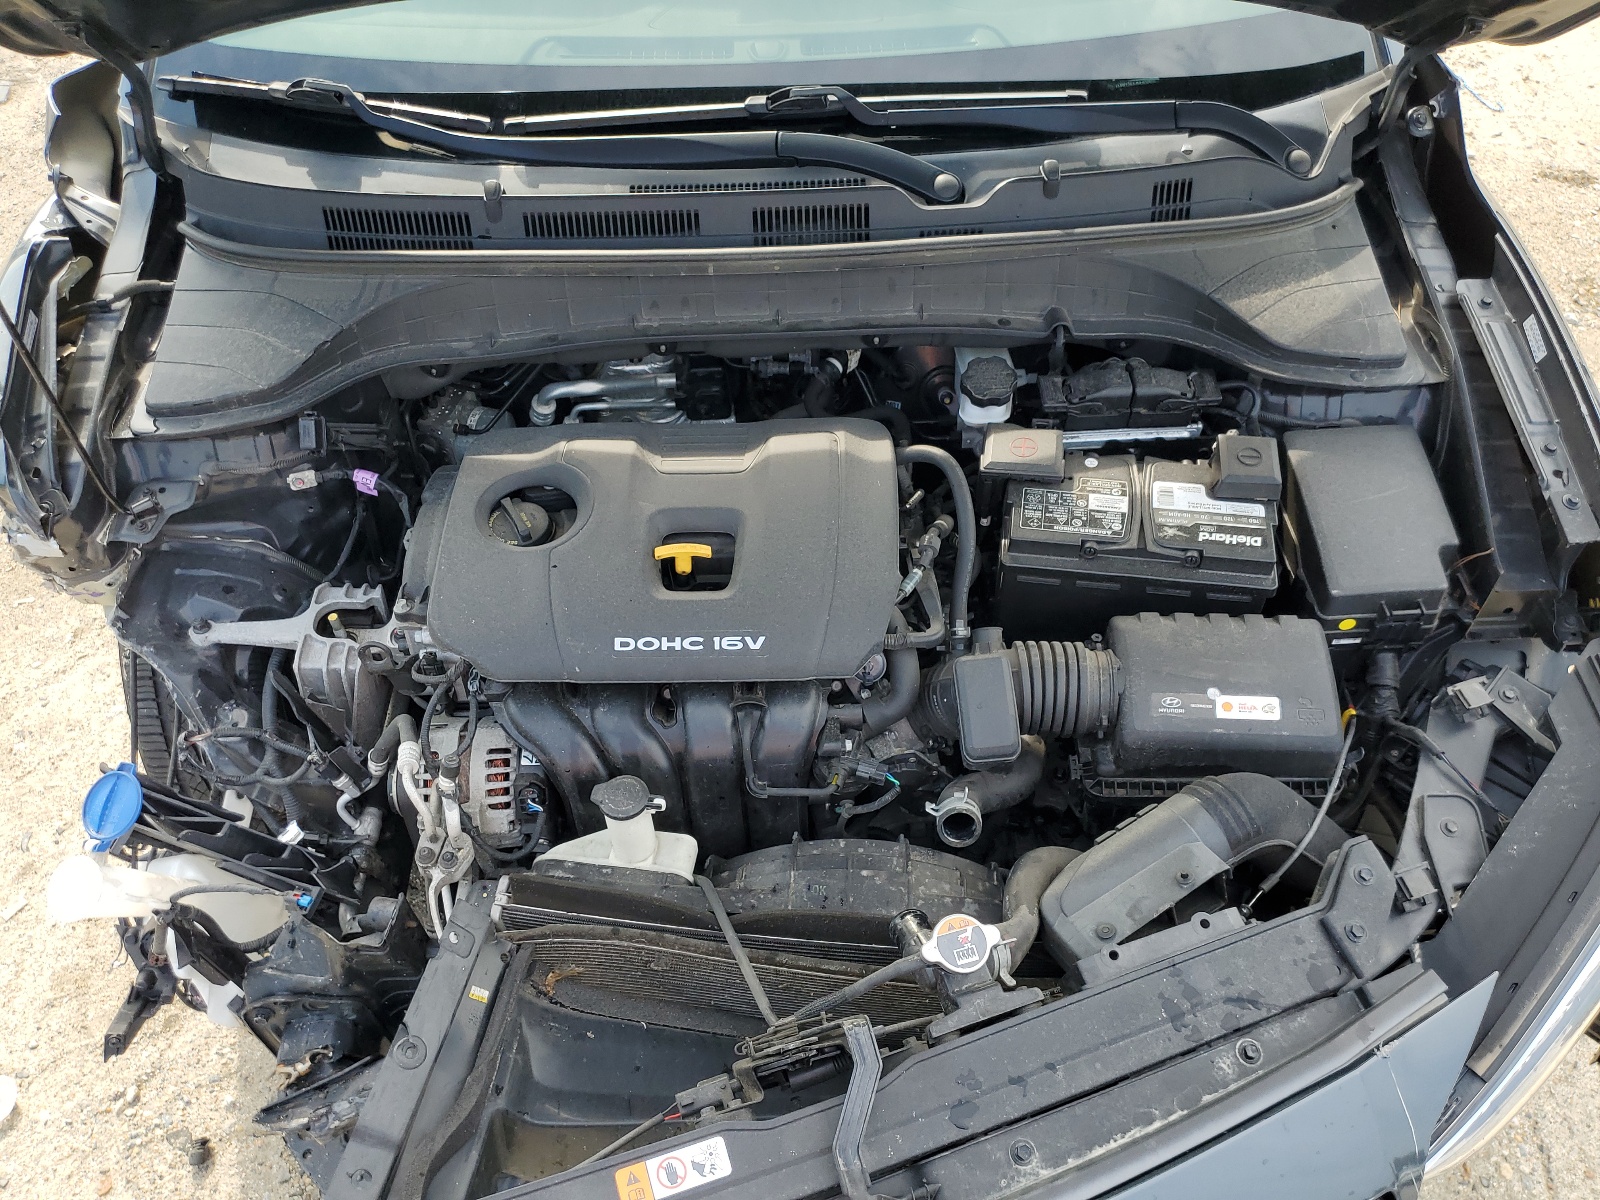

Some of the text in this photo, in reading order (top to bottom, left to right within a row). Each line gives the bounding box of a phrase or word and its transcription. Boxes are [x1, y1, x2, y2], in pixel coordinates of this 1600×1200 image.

[1198, 531, 1262, 547] DieHard
[613, 635, 766, 651] DOHC 16V
